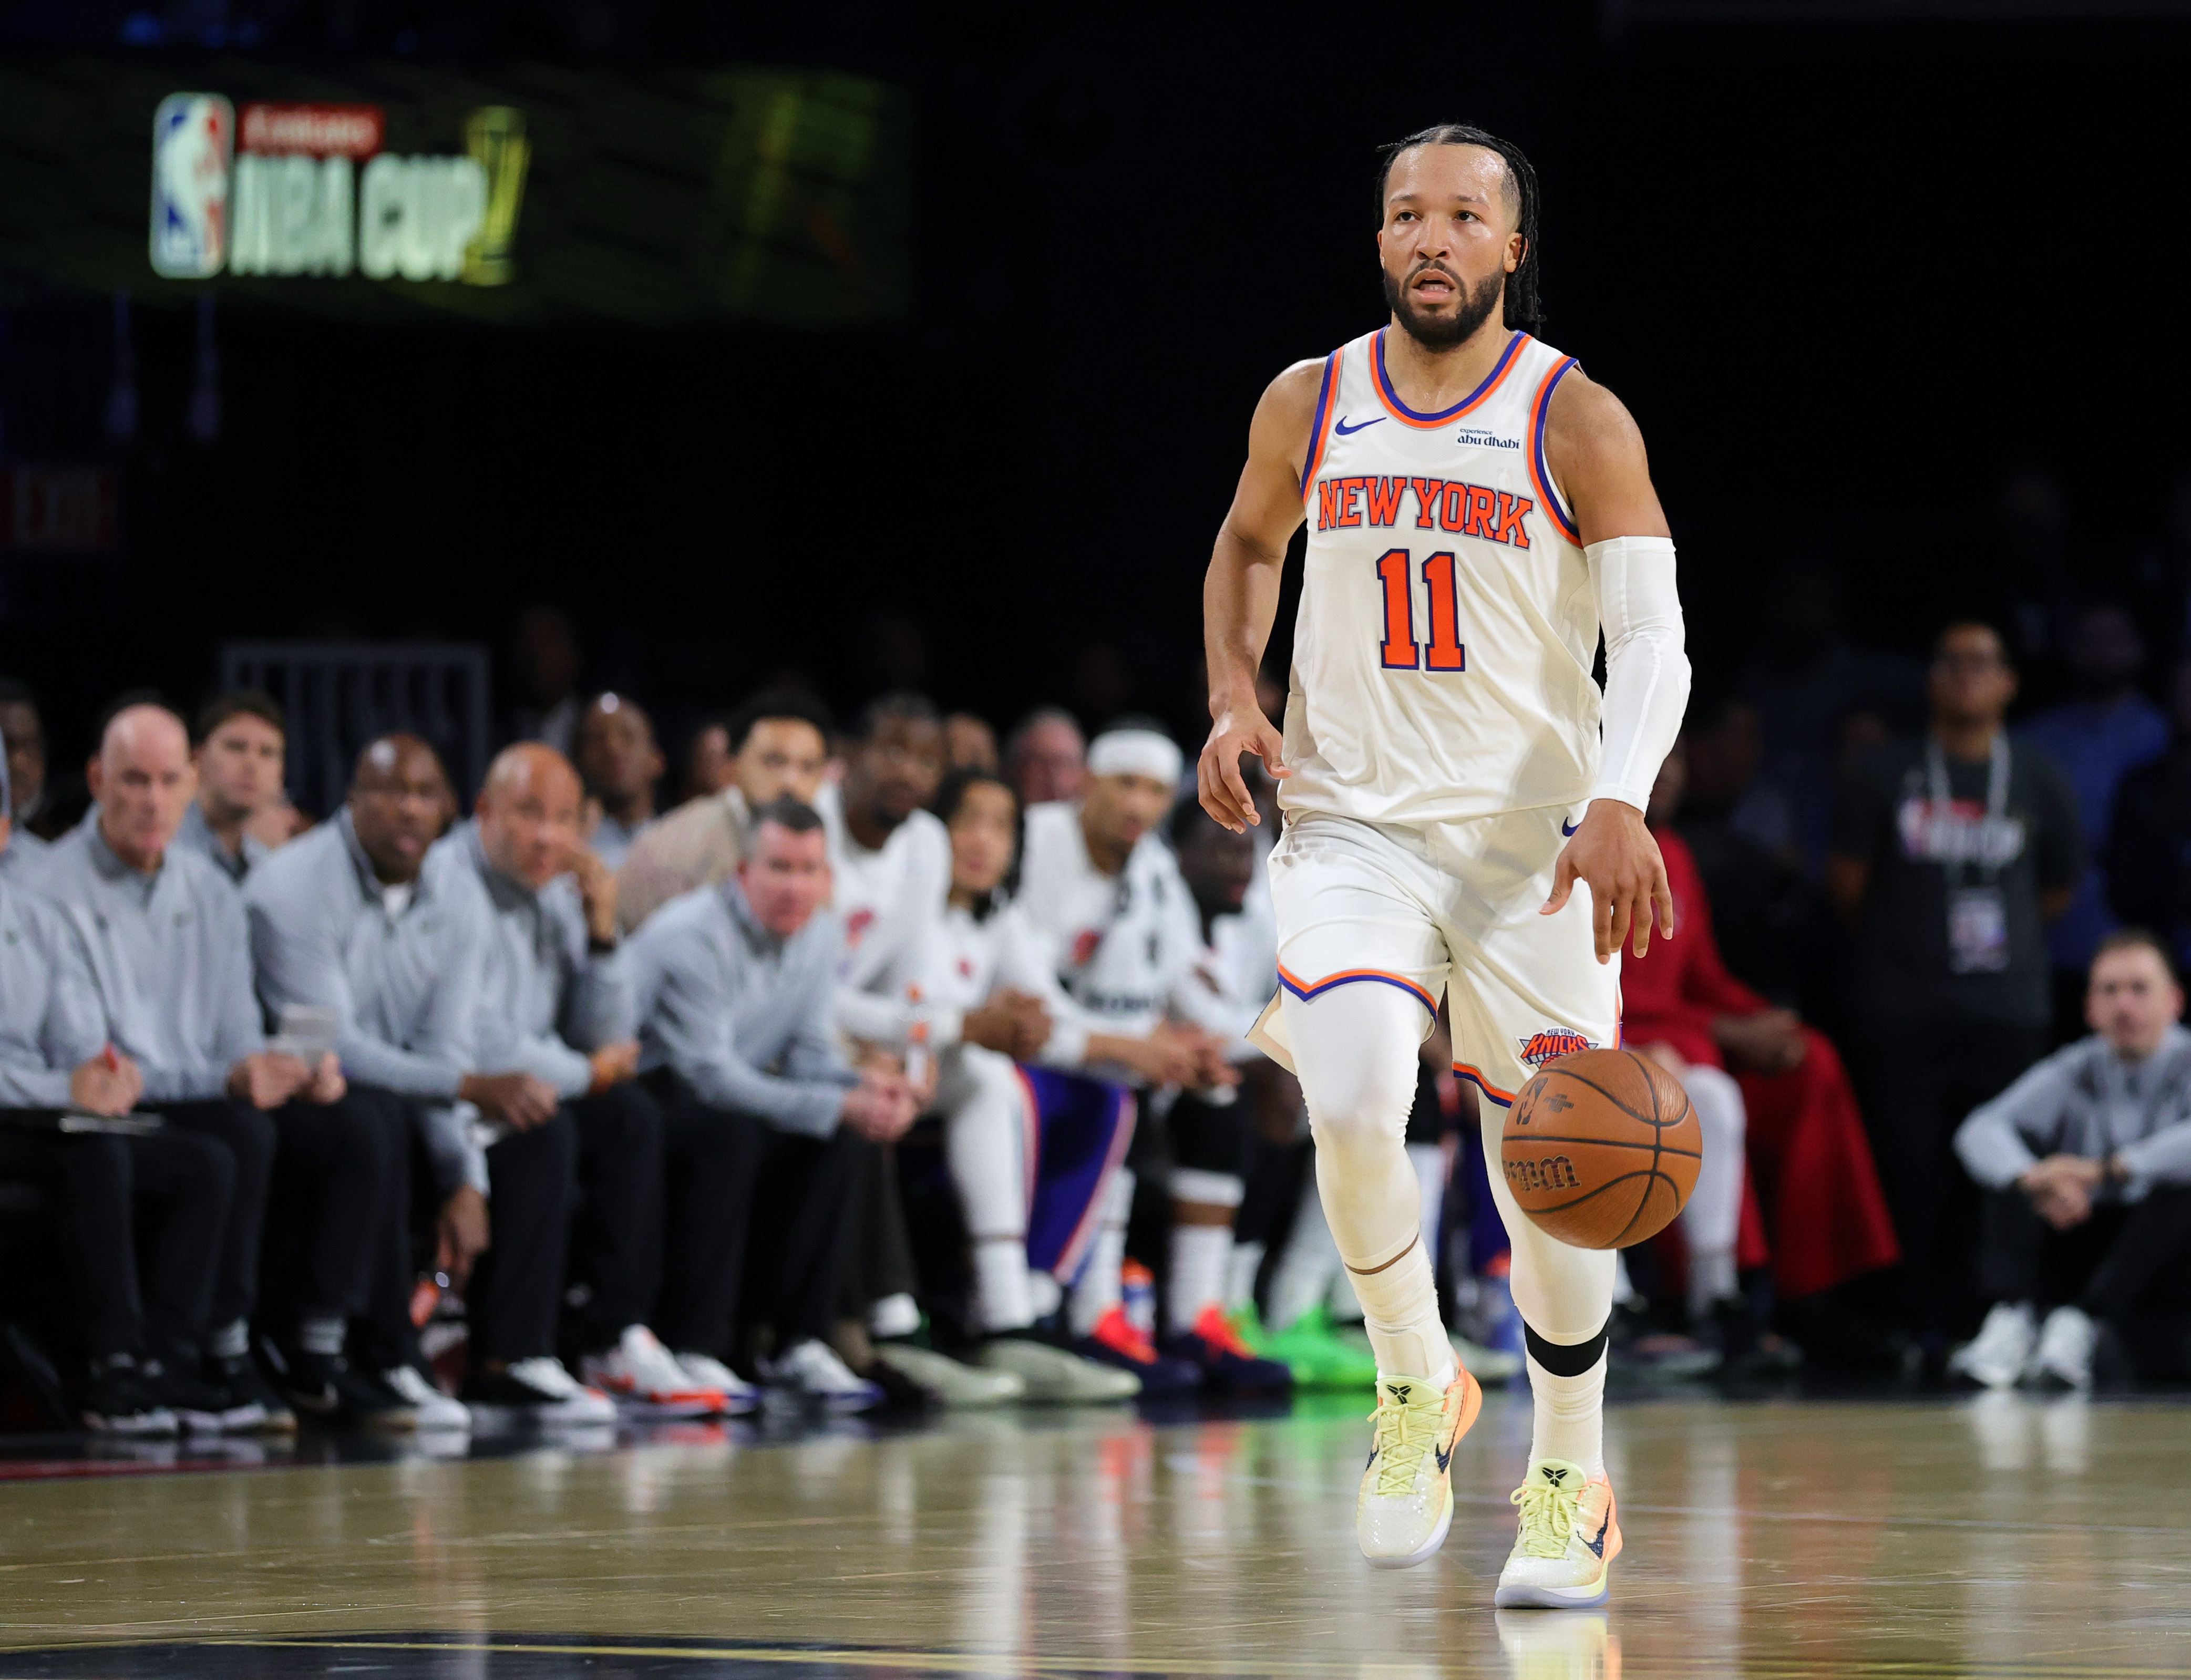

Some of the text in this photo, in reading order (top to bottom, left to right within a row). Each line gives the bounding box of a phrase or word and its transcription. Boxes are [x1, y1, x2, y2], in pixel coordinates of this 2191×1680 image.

[231, 152, 489, 281] NBA CUP
[1457, 435, 1520, 449] abu dhabi
[1318, 476, 1534, 552] NEW YORK
[1376, 548, 1465, 672] 11
[1520, 1033, 1591, 1059] KNICKS
[1560, 1028, 1576, 1037] YORK
